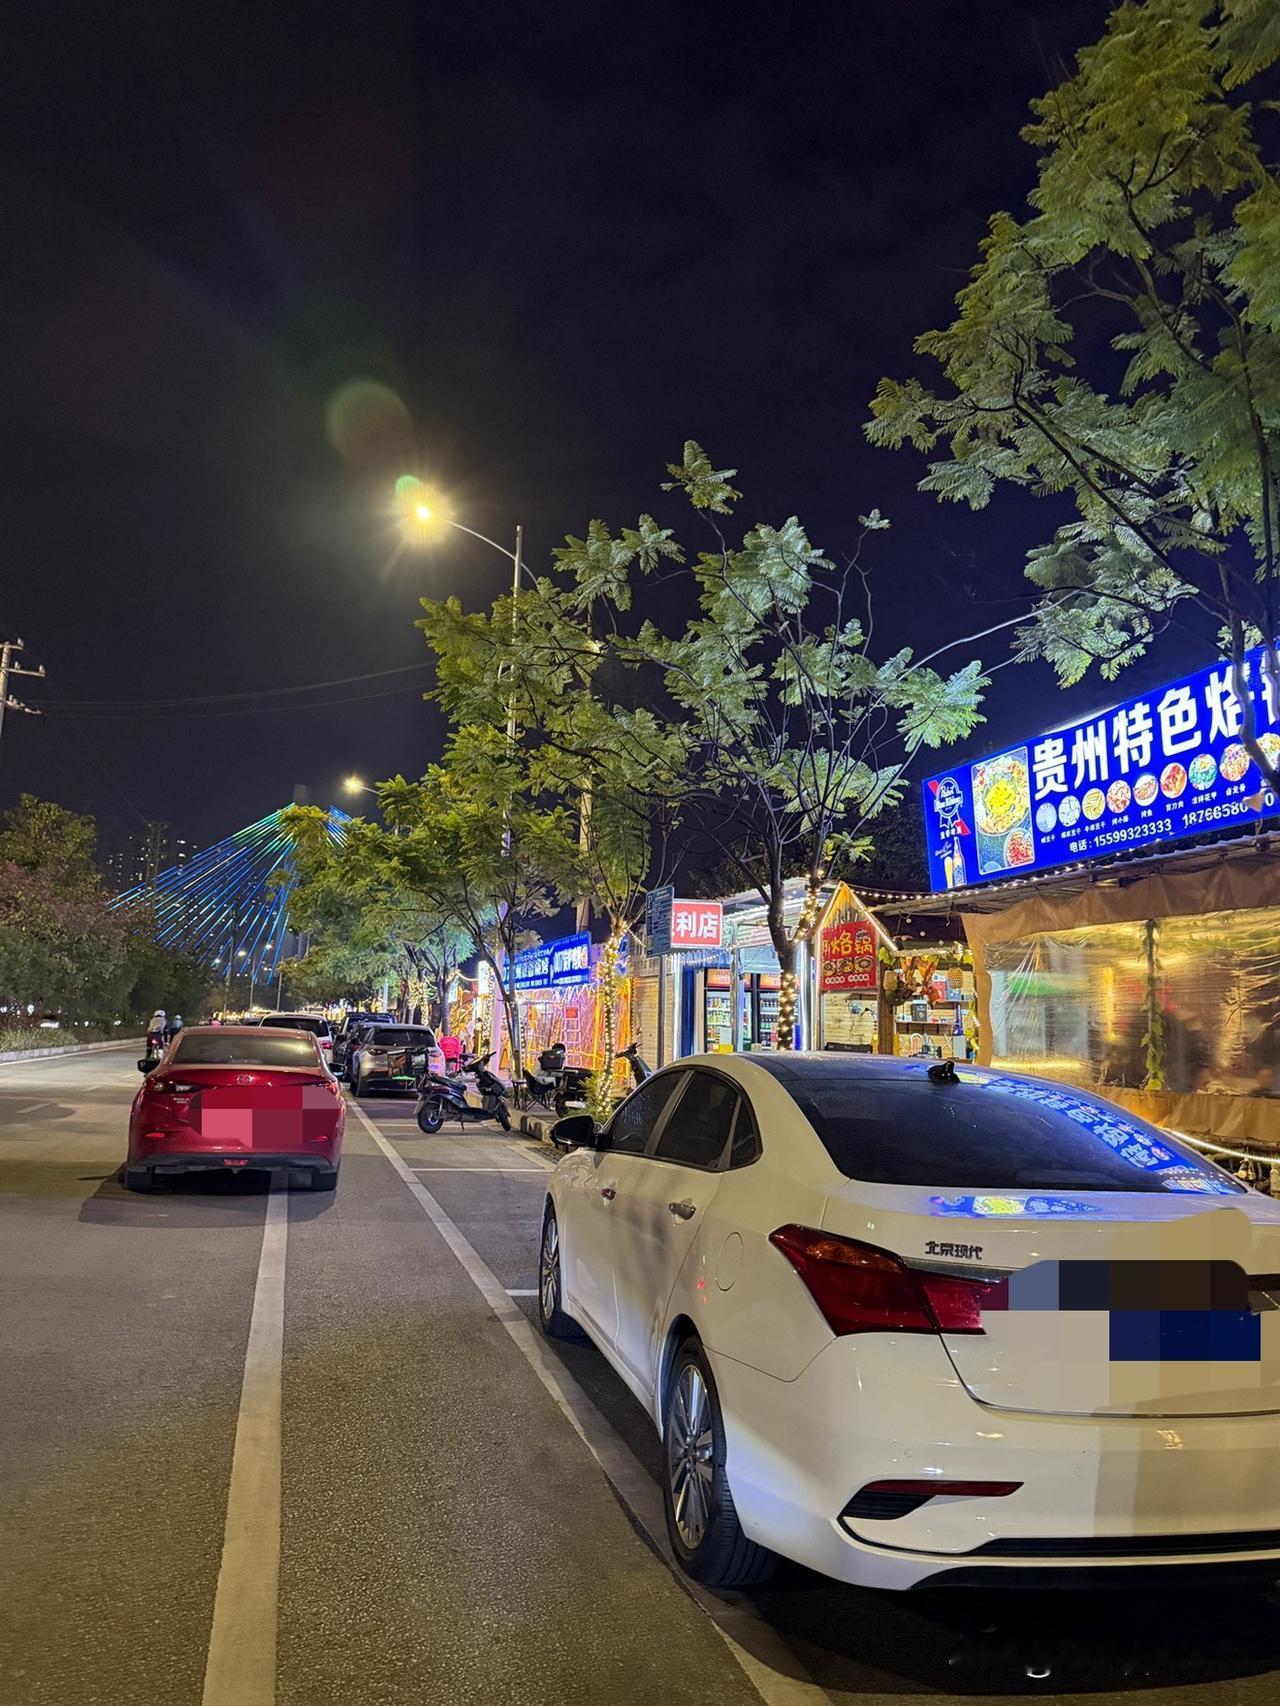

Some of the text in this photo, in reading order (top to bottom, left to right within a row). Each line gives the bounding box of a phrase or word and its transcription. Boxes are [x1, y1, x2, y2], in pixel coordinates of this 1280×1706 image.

[1031, 648, 1280, 801] 贵州特色烙
[671, 911, 719, 939] 利店
[924, 1240, 984, 1261] 北京现代
